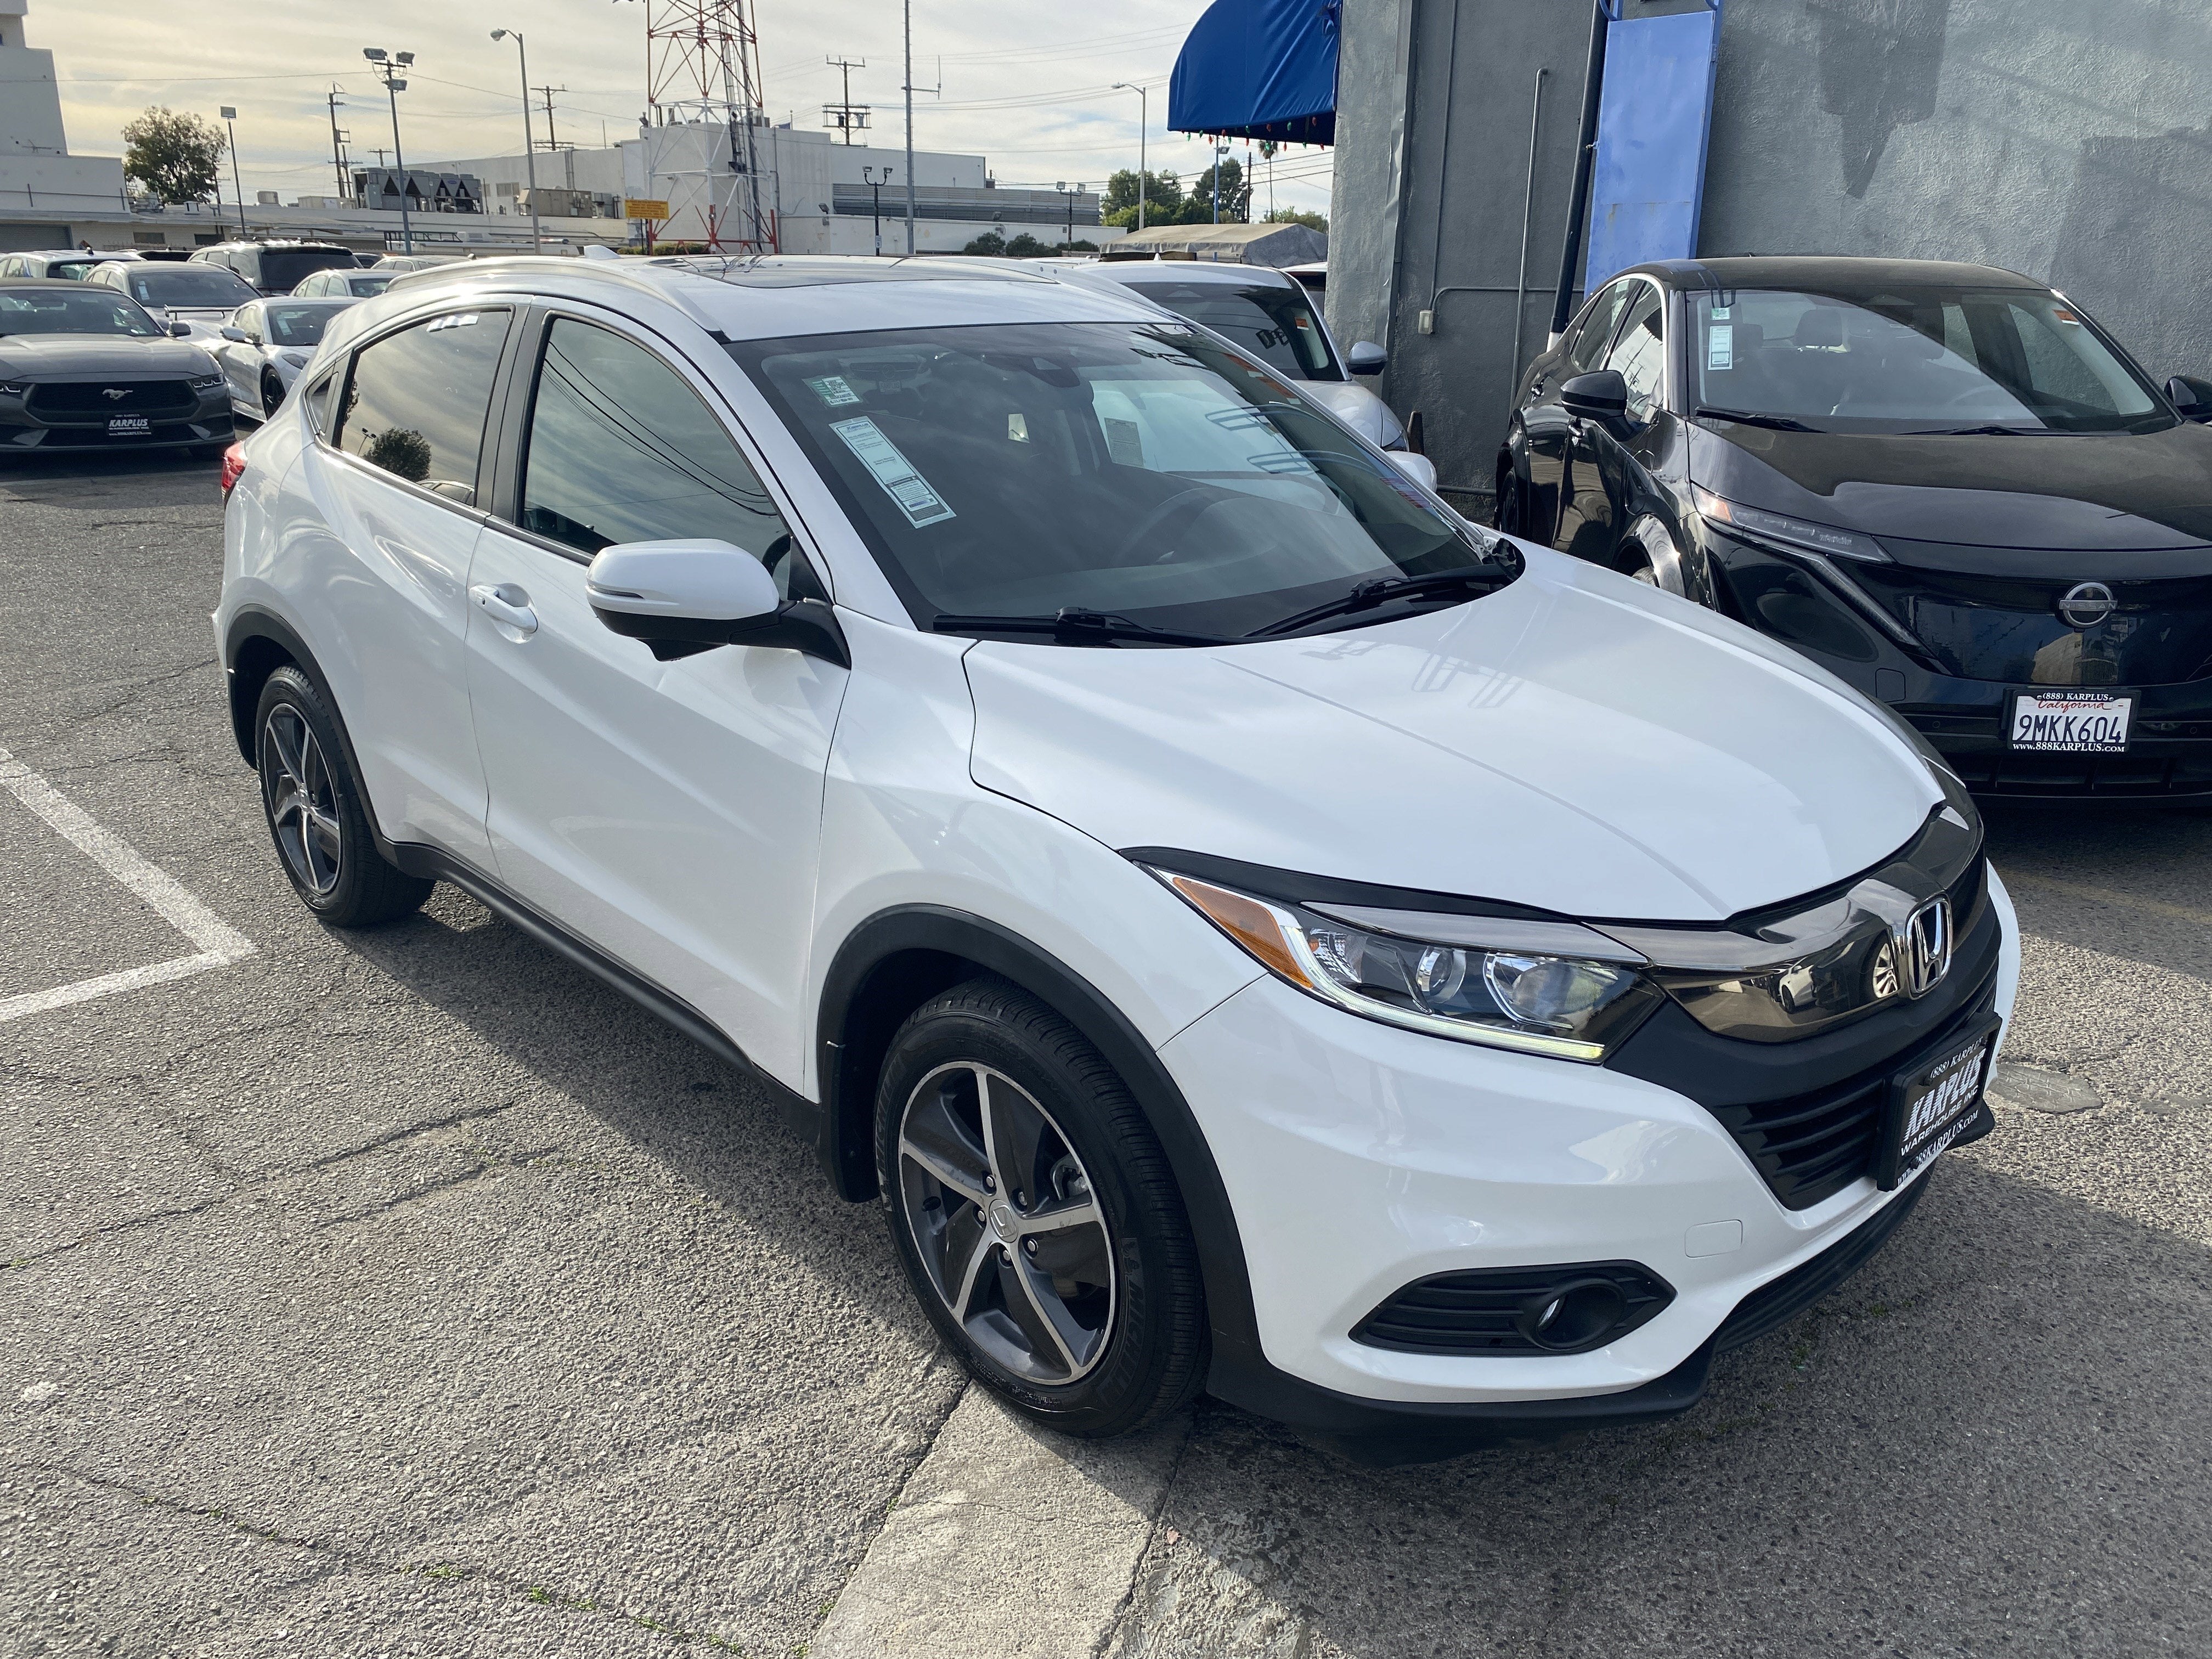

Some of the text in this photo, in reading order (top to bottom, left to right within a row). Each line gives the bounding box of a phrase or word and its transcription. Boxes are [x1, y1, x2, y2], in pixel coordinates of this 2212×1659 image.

[109, 419, 148, 427] KARPLUS
[2038, 699, 2112, 713] California
[2016, 714, 2121, 743] 9MKK604
[1930, 1060, 1950, 1079] (888)
[1903, 1048, 1987, 1142] KARPLUS
[1901, 1085, 1978, 1156] WAREHOUSE INC
